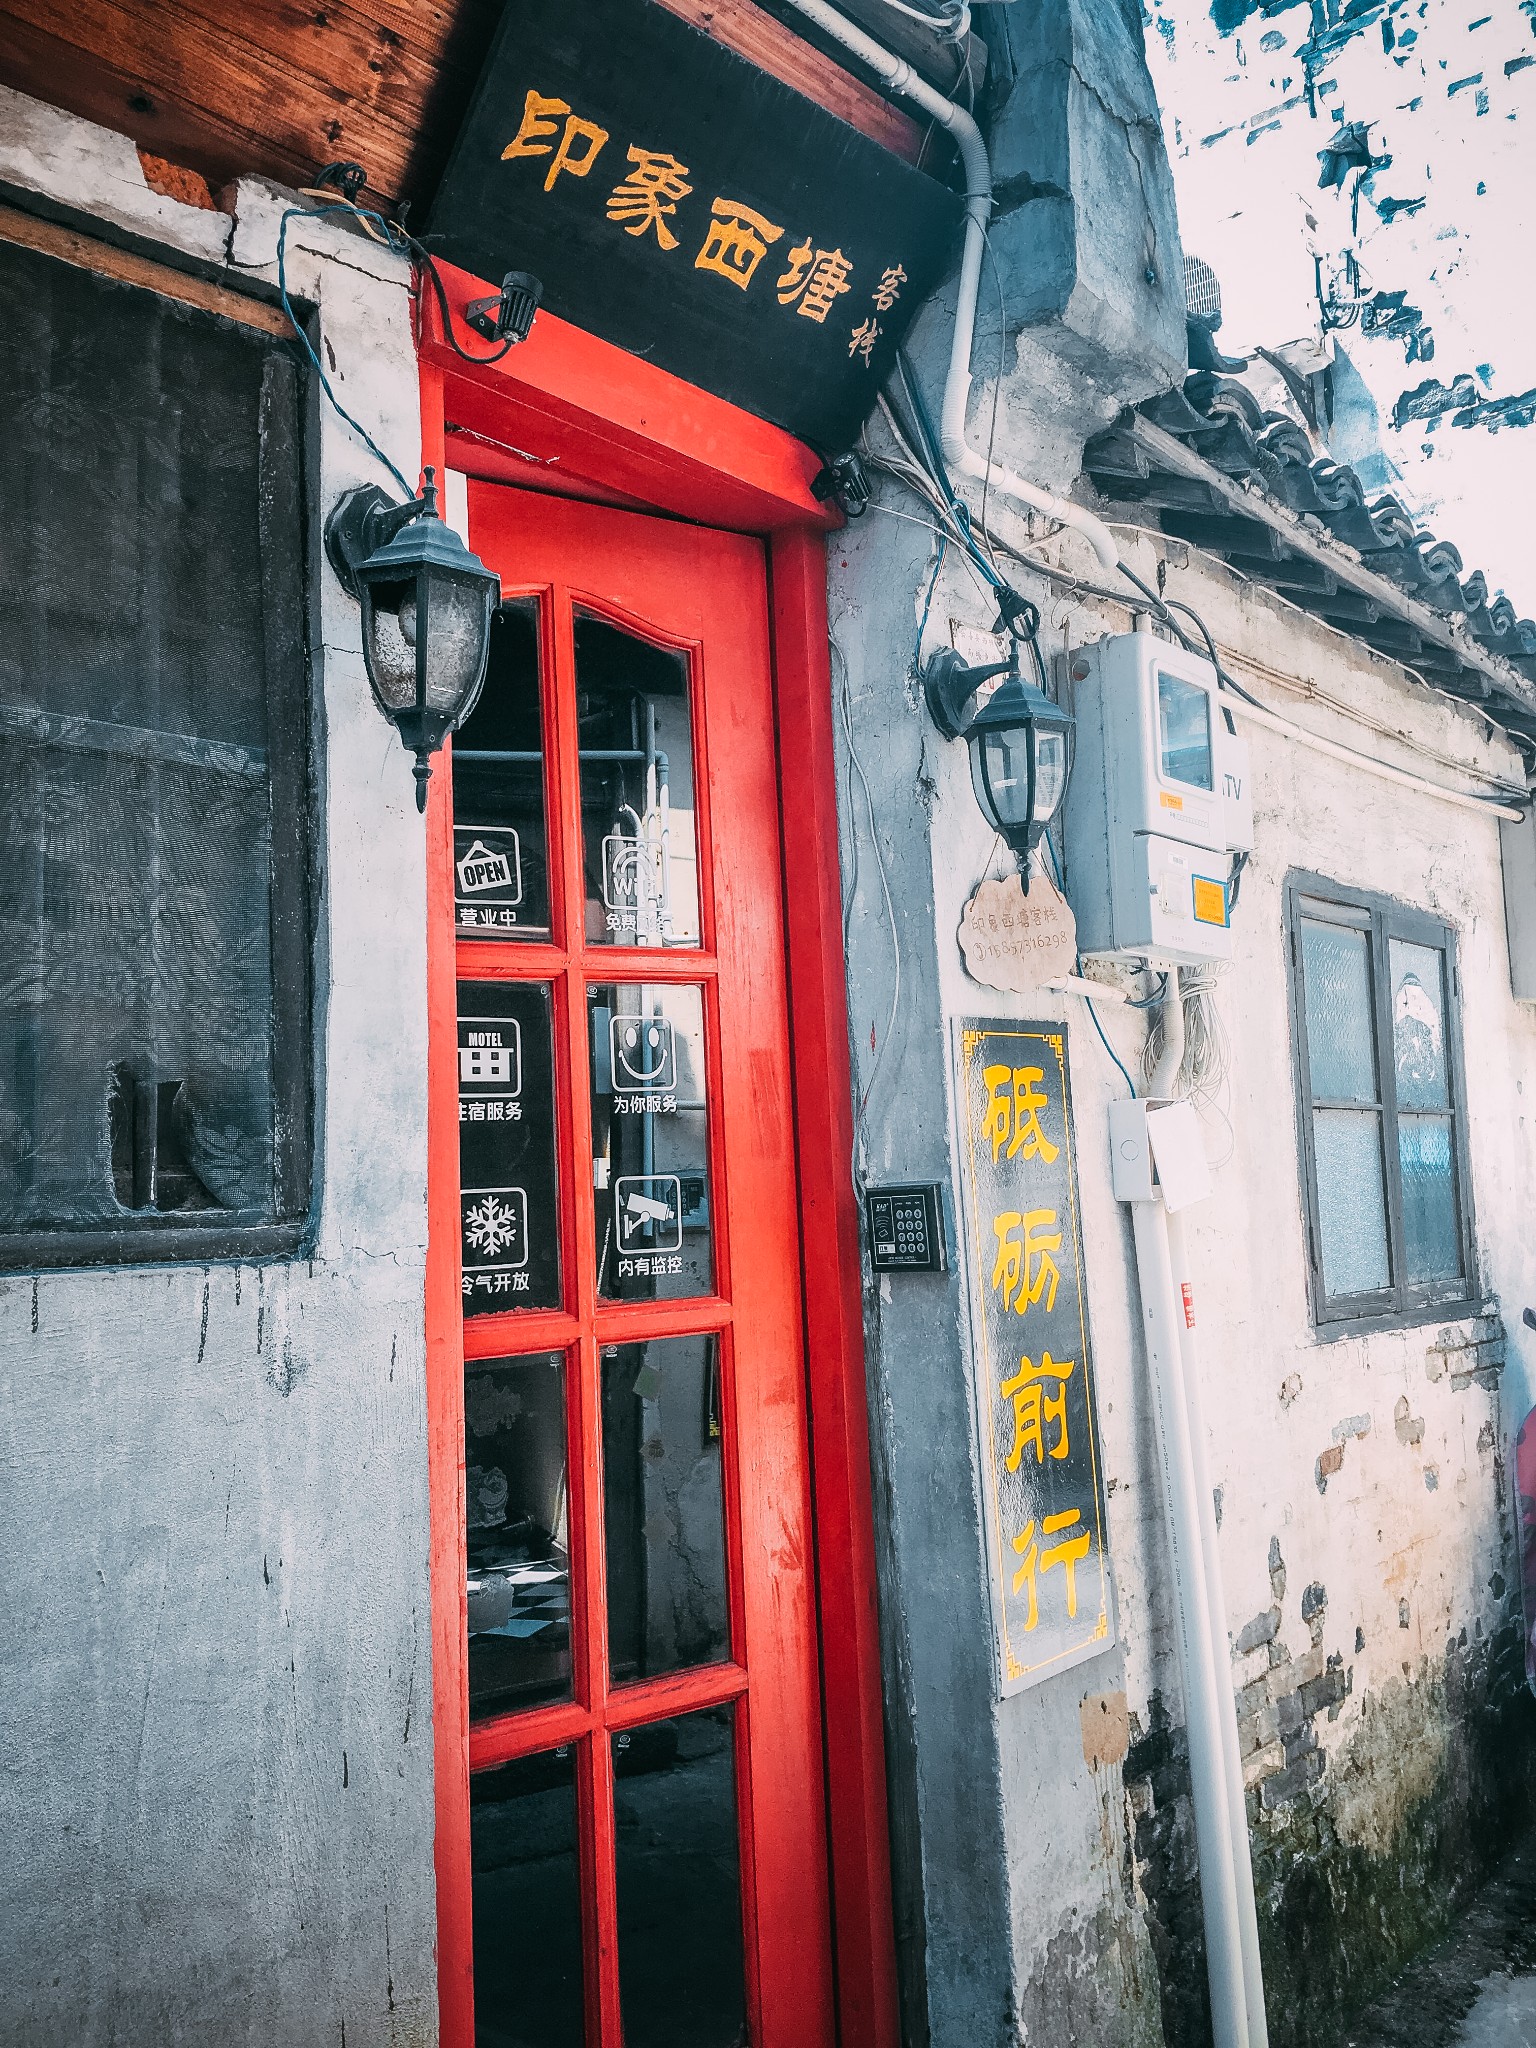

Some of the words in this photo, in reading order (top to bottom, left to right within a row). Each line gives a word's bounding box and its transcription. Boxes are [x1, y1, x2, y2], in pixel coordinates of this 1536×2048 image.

[501, 90, 853, 323] 印象西塘
[848, 263, 908, 368] 客栈
[1222, 773, 1241, 800] TV
[463, 860, 507, 887] OPEN
[459, 908, 517, 927] 营业中
[468, 1032, 503, 1047] MOTEL
[613, 1094, 678, 1114] 为你服务
[618, 1255, 683, 1277] 内有监控
[982, 1064, 1091, 1633] 砥砺前行
